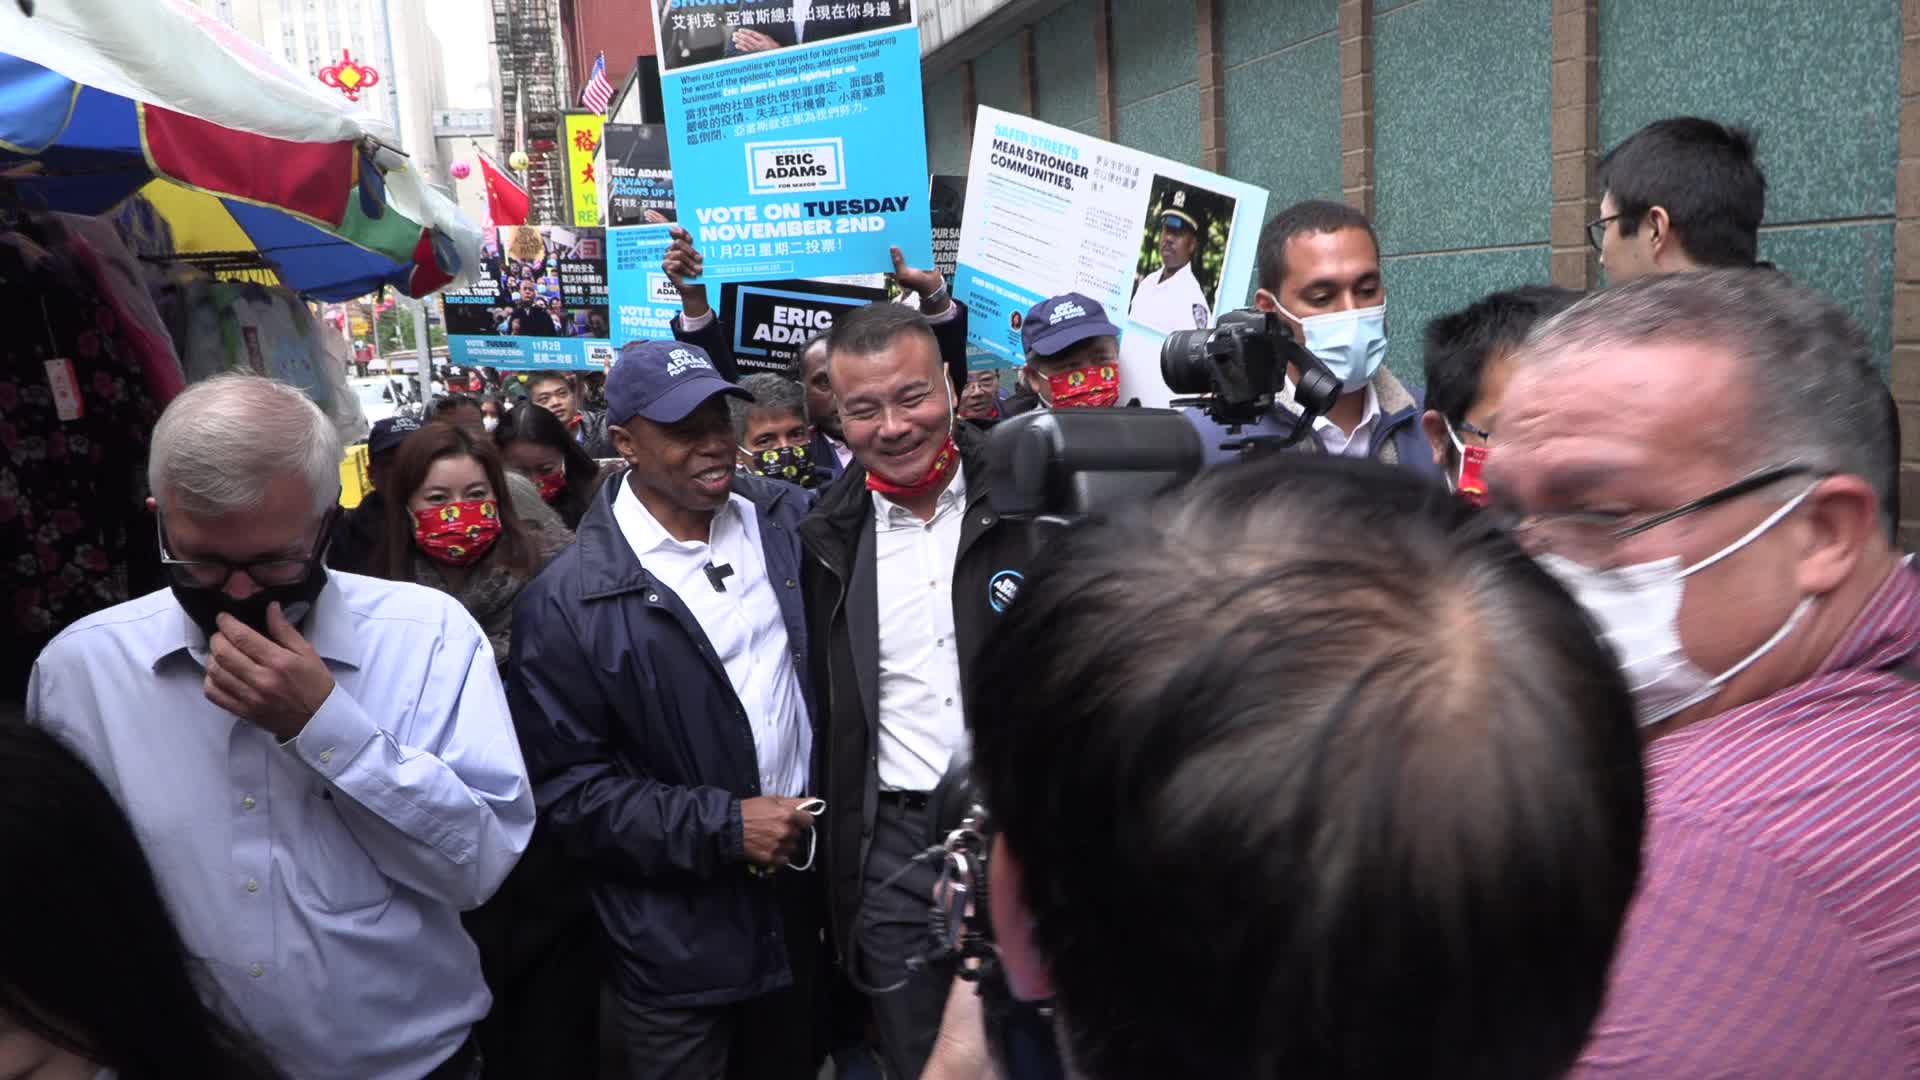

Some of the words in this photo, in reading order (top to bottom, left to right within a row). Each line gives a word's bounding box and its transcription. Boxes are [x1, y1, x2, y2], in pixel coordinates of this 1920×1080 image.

[993, 123, 1029, 142] SAFER
[1029, 134, 1081, 161] STREETS
[775, 153, 815, 167] ERIC
[992, 138, 1026, 159] MEAN
[1026, 149, 1089, 180] STRONGER
[612, 167, 636, 177] ERIC
[765, 164, 828, 180] ADAMS
[990, 152, 1075, 192] COMMUNITIES.
[695, 204, 758, 225] VOTE
[764, 201, 800, 220] ON
[803, 196, 910, 218] TUESDAY
[700, 218, 833, 243] NOVEMBER
[835, 215, 886, 234] 2ND
[619, 305, 651, 316] VOTE
[773, 305, 834, 329] ERIC
[771, 350, 791, 359] FOR
